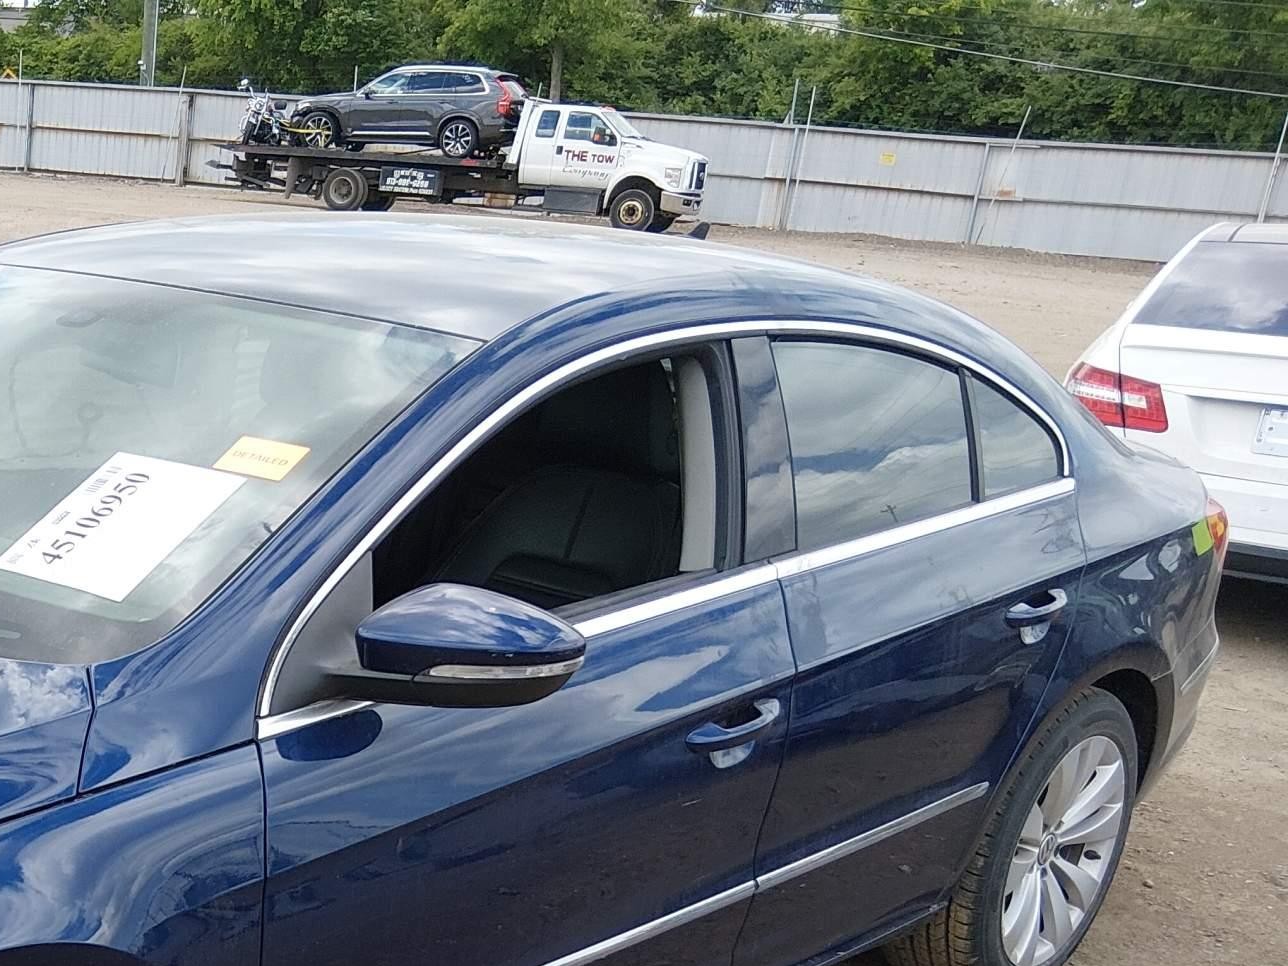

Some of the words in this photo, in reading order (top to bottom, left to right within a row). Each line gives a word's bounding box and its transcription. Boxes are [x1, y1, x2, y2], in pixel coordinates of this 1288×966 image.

[564, 149, 589, 162] THE
[591, 153, 615, 164] TOW
[41, 472, 150, 565] 45106950
